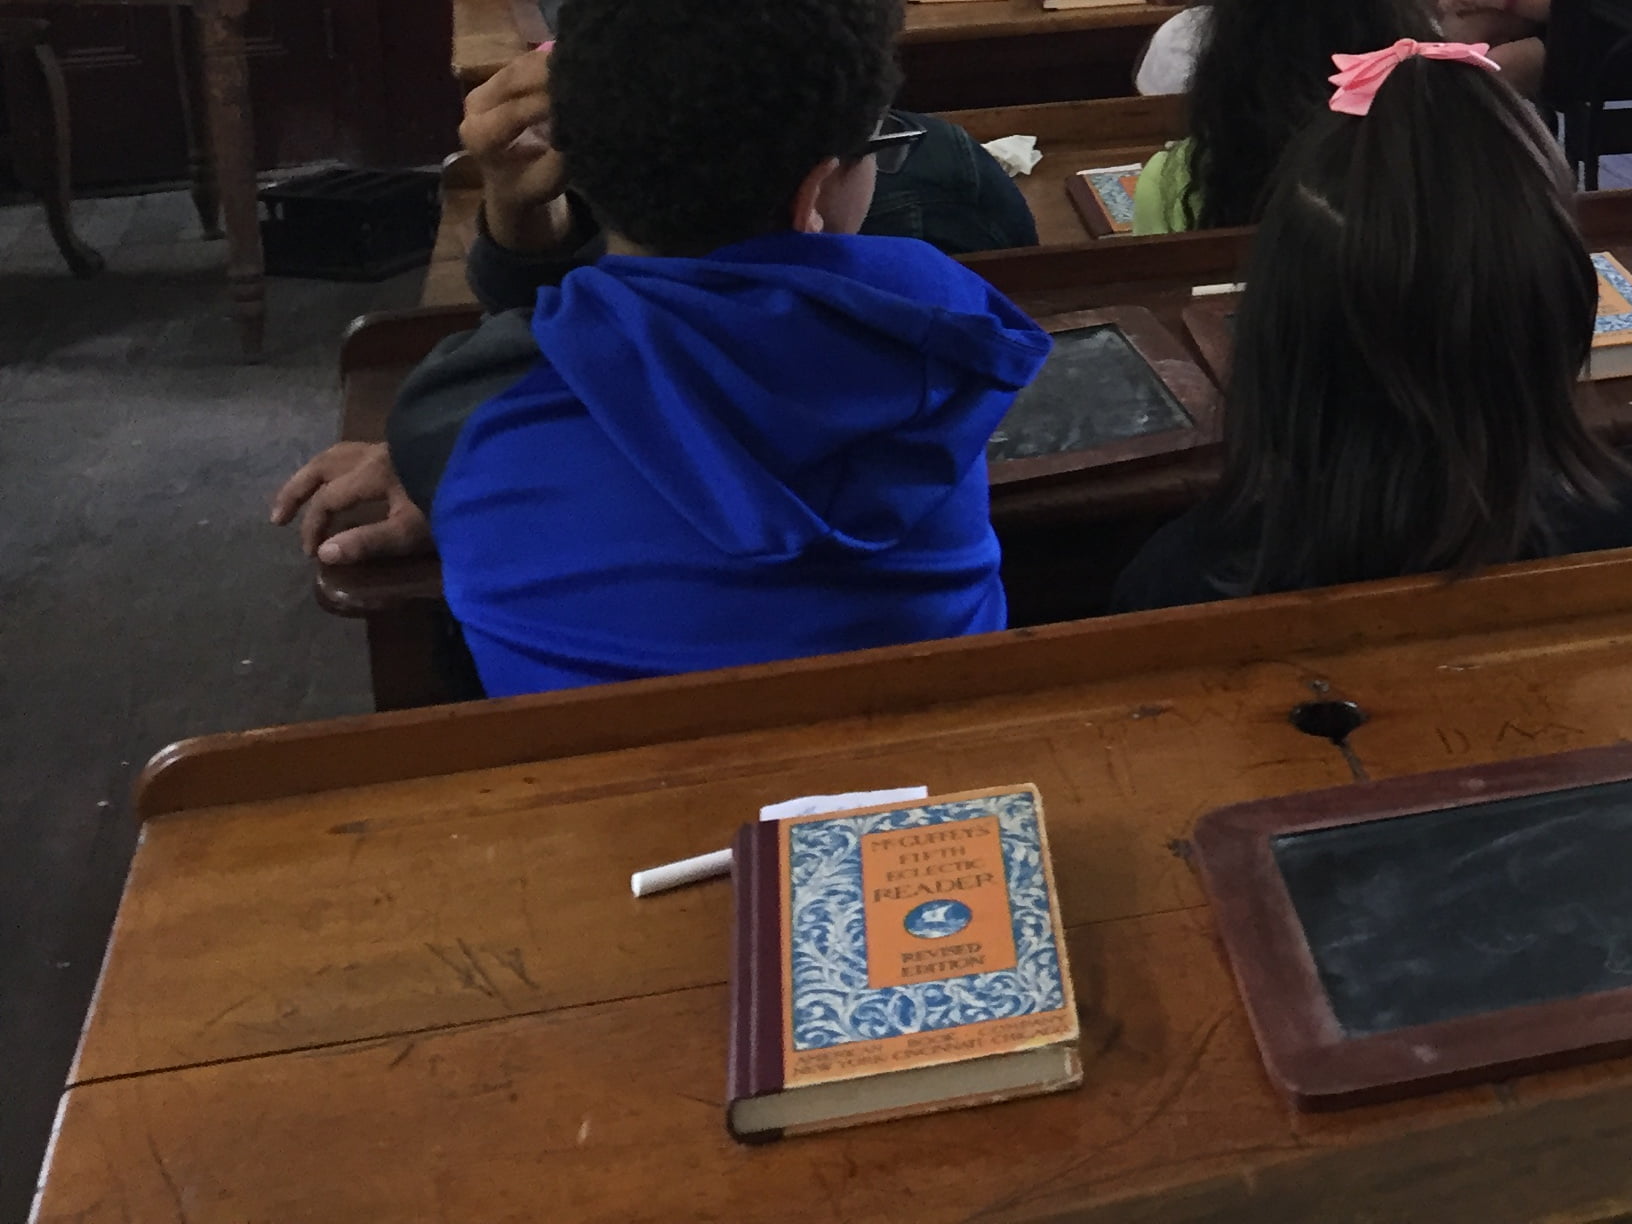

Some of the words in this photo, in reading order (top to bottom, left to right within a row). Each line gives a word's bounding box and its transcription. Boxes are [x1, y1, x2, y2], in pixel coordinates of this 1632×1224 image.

[899, 845, 967, 865] FIFTH
[873, 872, 998, 902] READER
[901, 942, 982, 963] REVISED
[901, 955, 985, 978] EDITION
